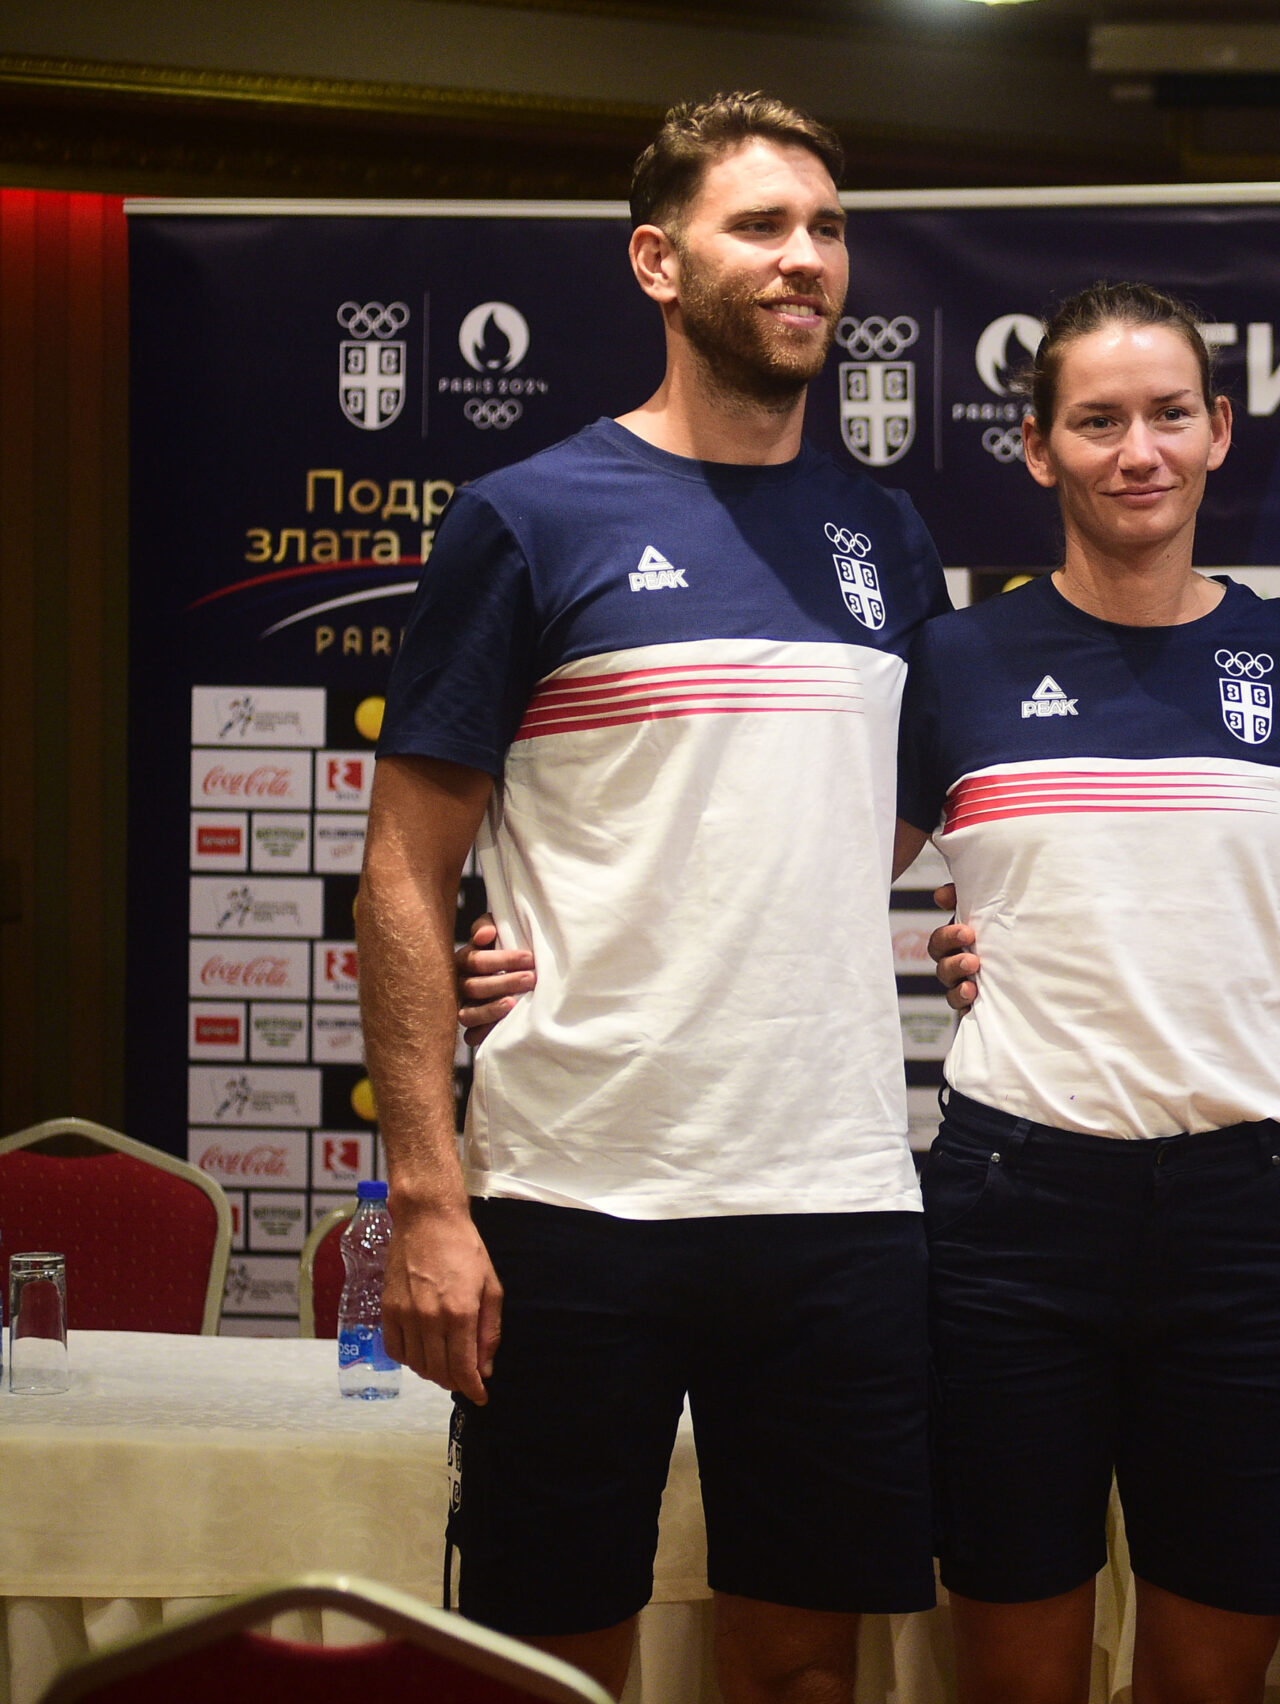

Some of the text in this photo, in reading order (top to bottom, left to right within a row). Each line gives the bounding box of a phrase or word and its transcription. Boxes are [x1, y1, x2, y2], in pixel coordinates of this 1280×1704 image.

[497, 377, 549, 395] 2024
[306, 469, 456, 526] Подр
[245, 528, 399, 565] злата
[628, 568, 690, 592] PEAK
[1021, 698, 1079, 719] PEAK
[339, 1342, 360, 1356] osa
